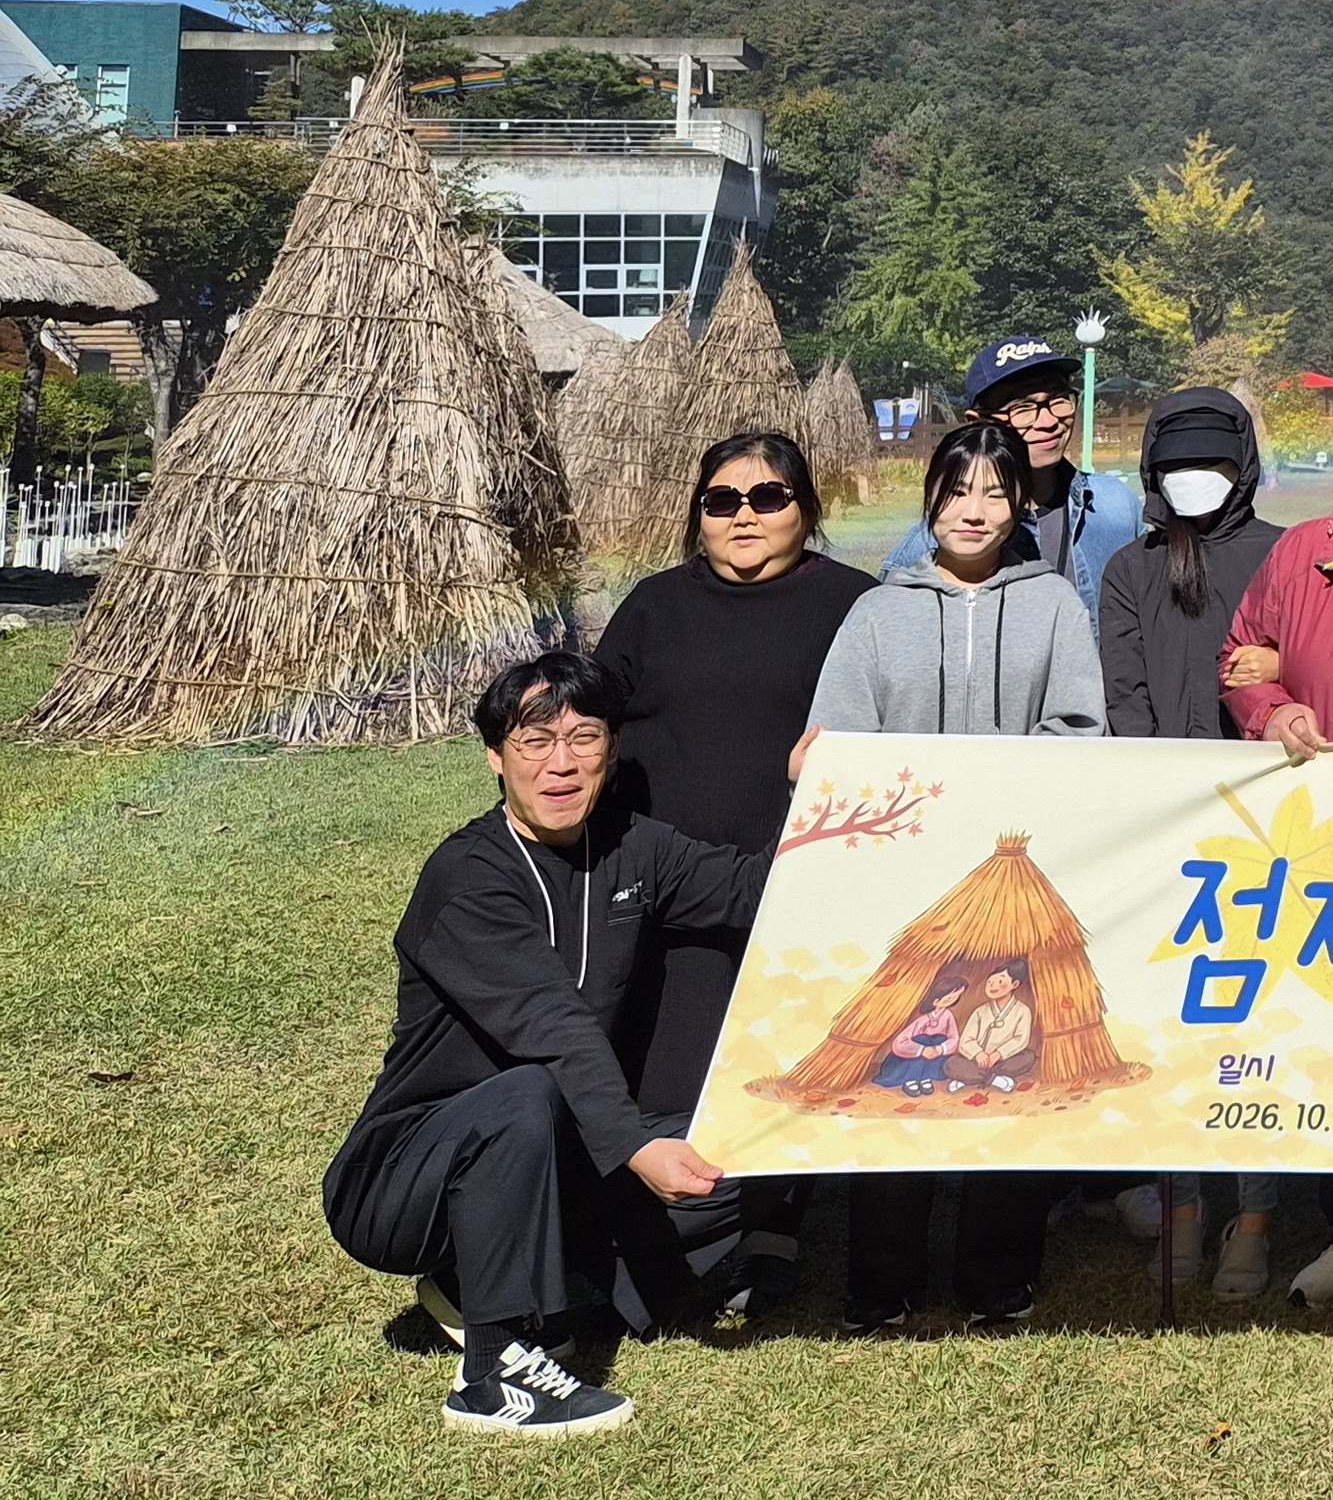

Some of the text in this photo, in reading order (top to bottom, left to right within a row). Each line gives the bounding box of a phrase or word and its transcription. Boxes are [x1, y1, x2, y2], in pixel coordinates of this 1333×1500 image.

[995, 340, 1053, 367] Ralph
[1218, 1053, 1275, 1085] 일시
[1205, 1102, 1284, 1132] 2026.
[1297, 1103, 1331, 1132] 10.
